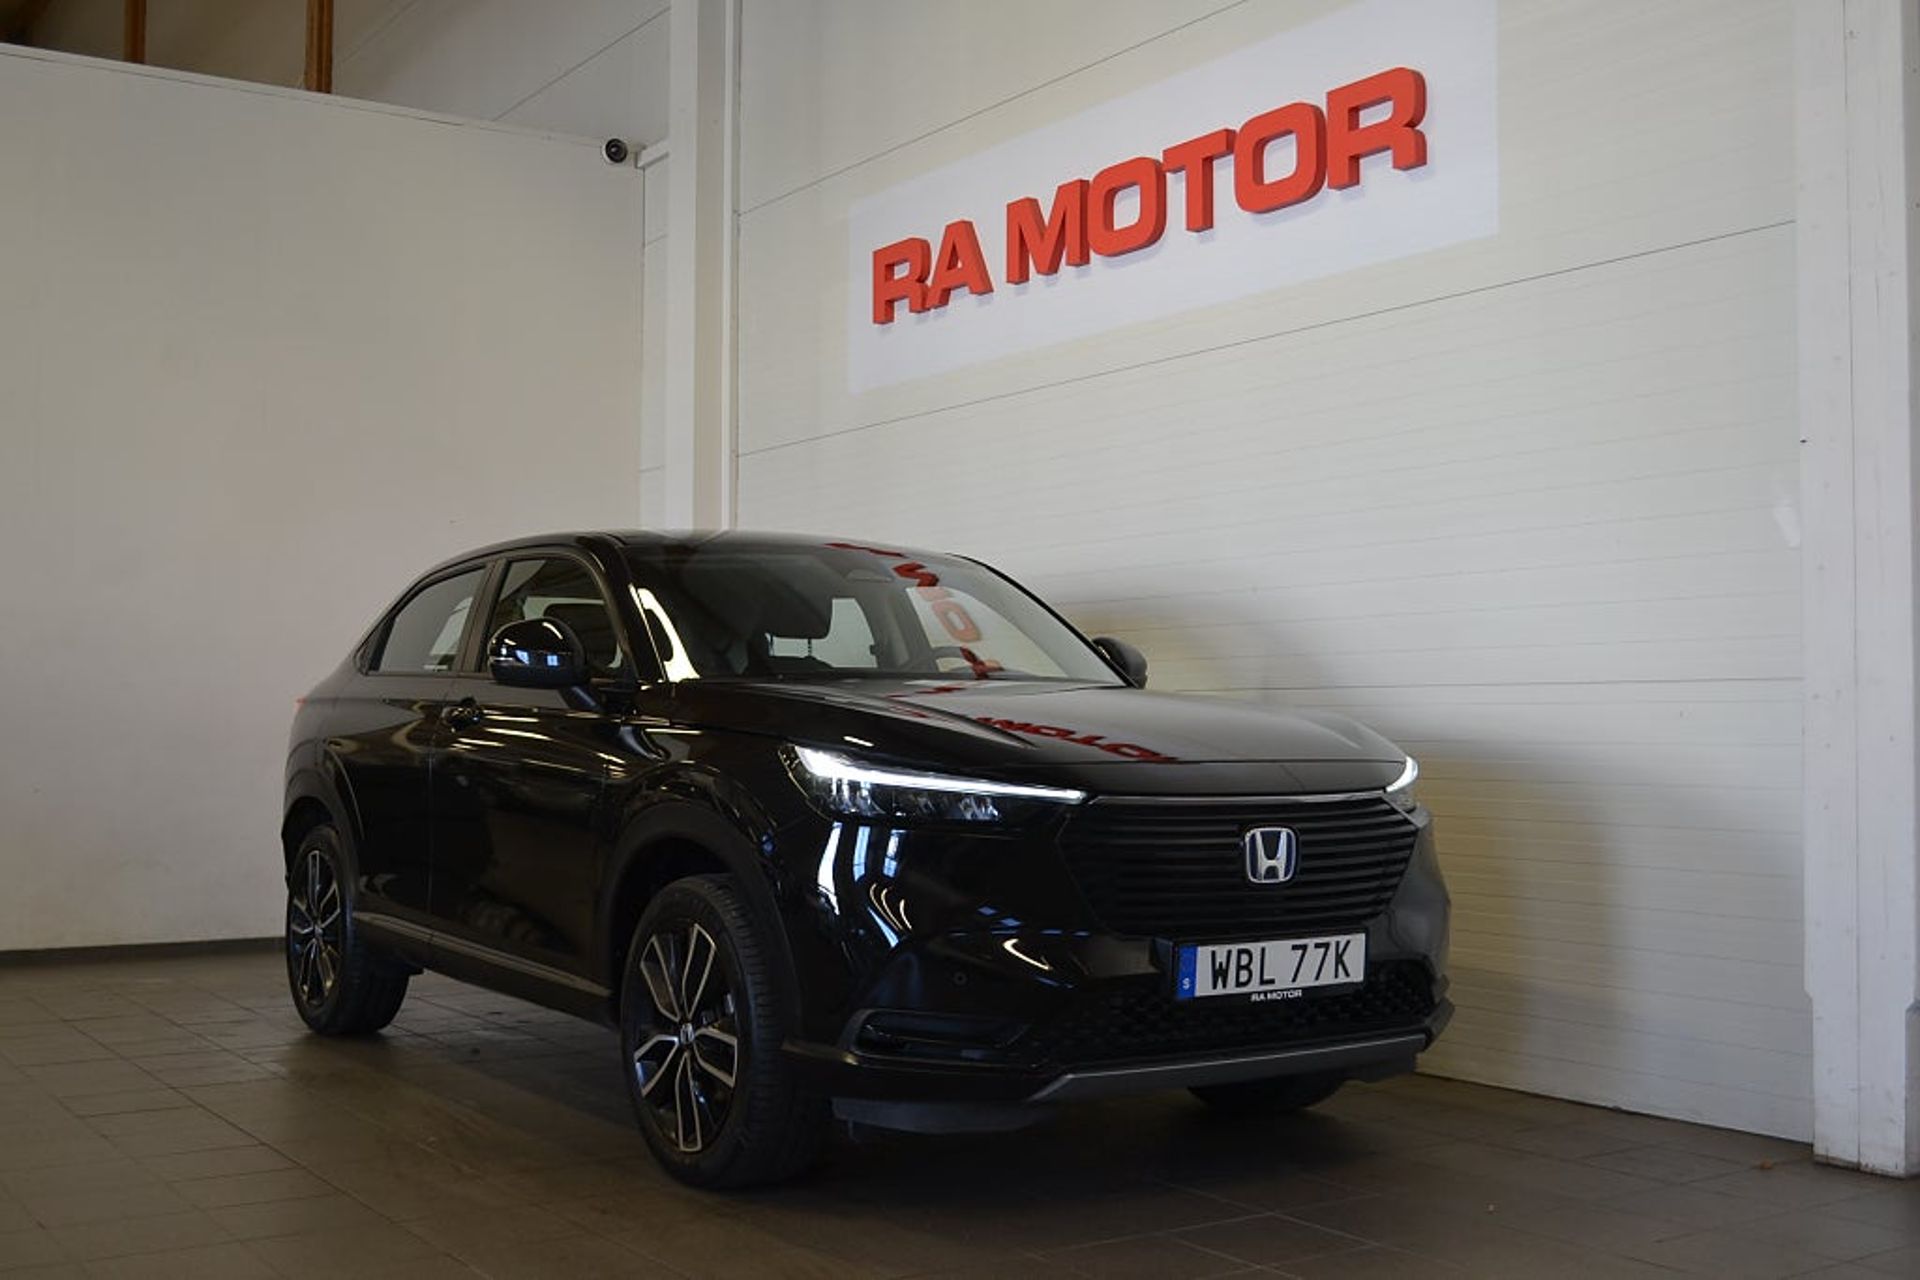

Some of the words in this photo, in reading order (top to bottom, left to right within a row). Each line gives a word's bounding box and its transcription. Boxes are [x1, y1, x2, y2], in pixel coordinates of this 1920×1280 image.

[872, 217, 994, 325] RA
[1006, 66, 1428, 285] MOTOR
[1210, 946, 1276, 990] WBL
[1290, 939, 1352, 984] 77K
[1182, 977, 1191, 990] S
[1266, 989, 1303, 1001] MOTOR
